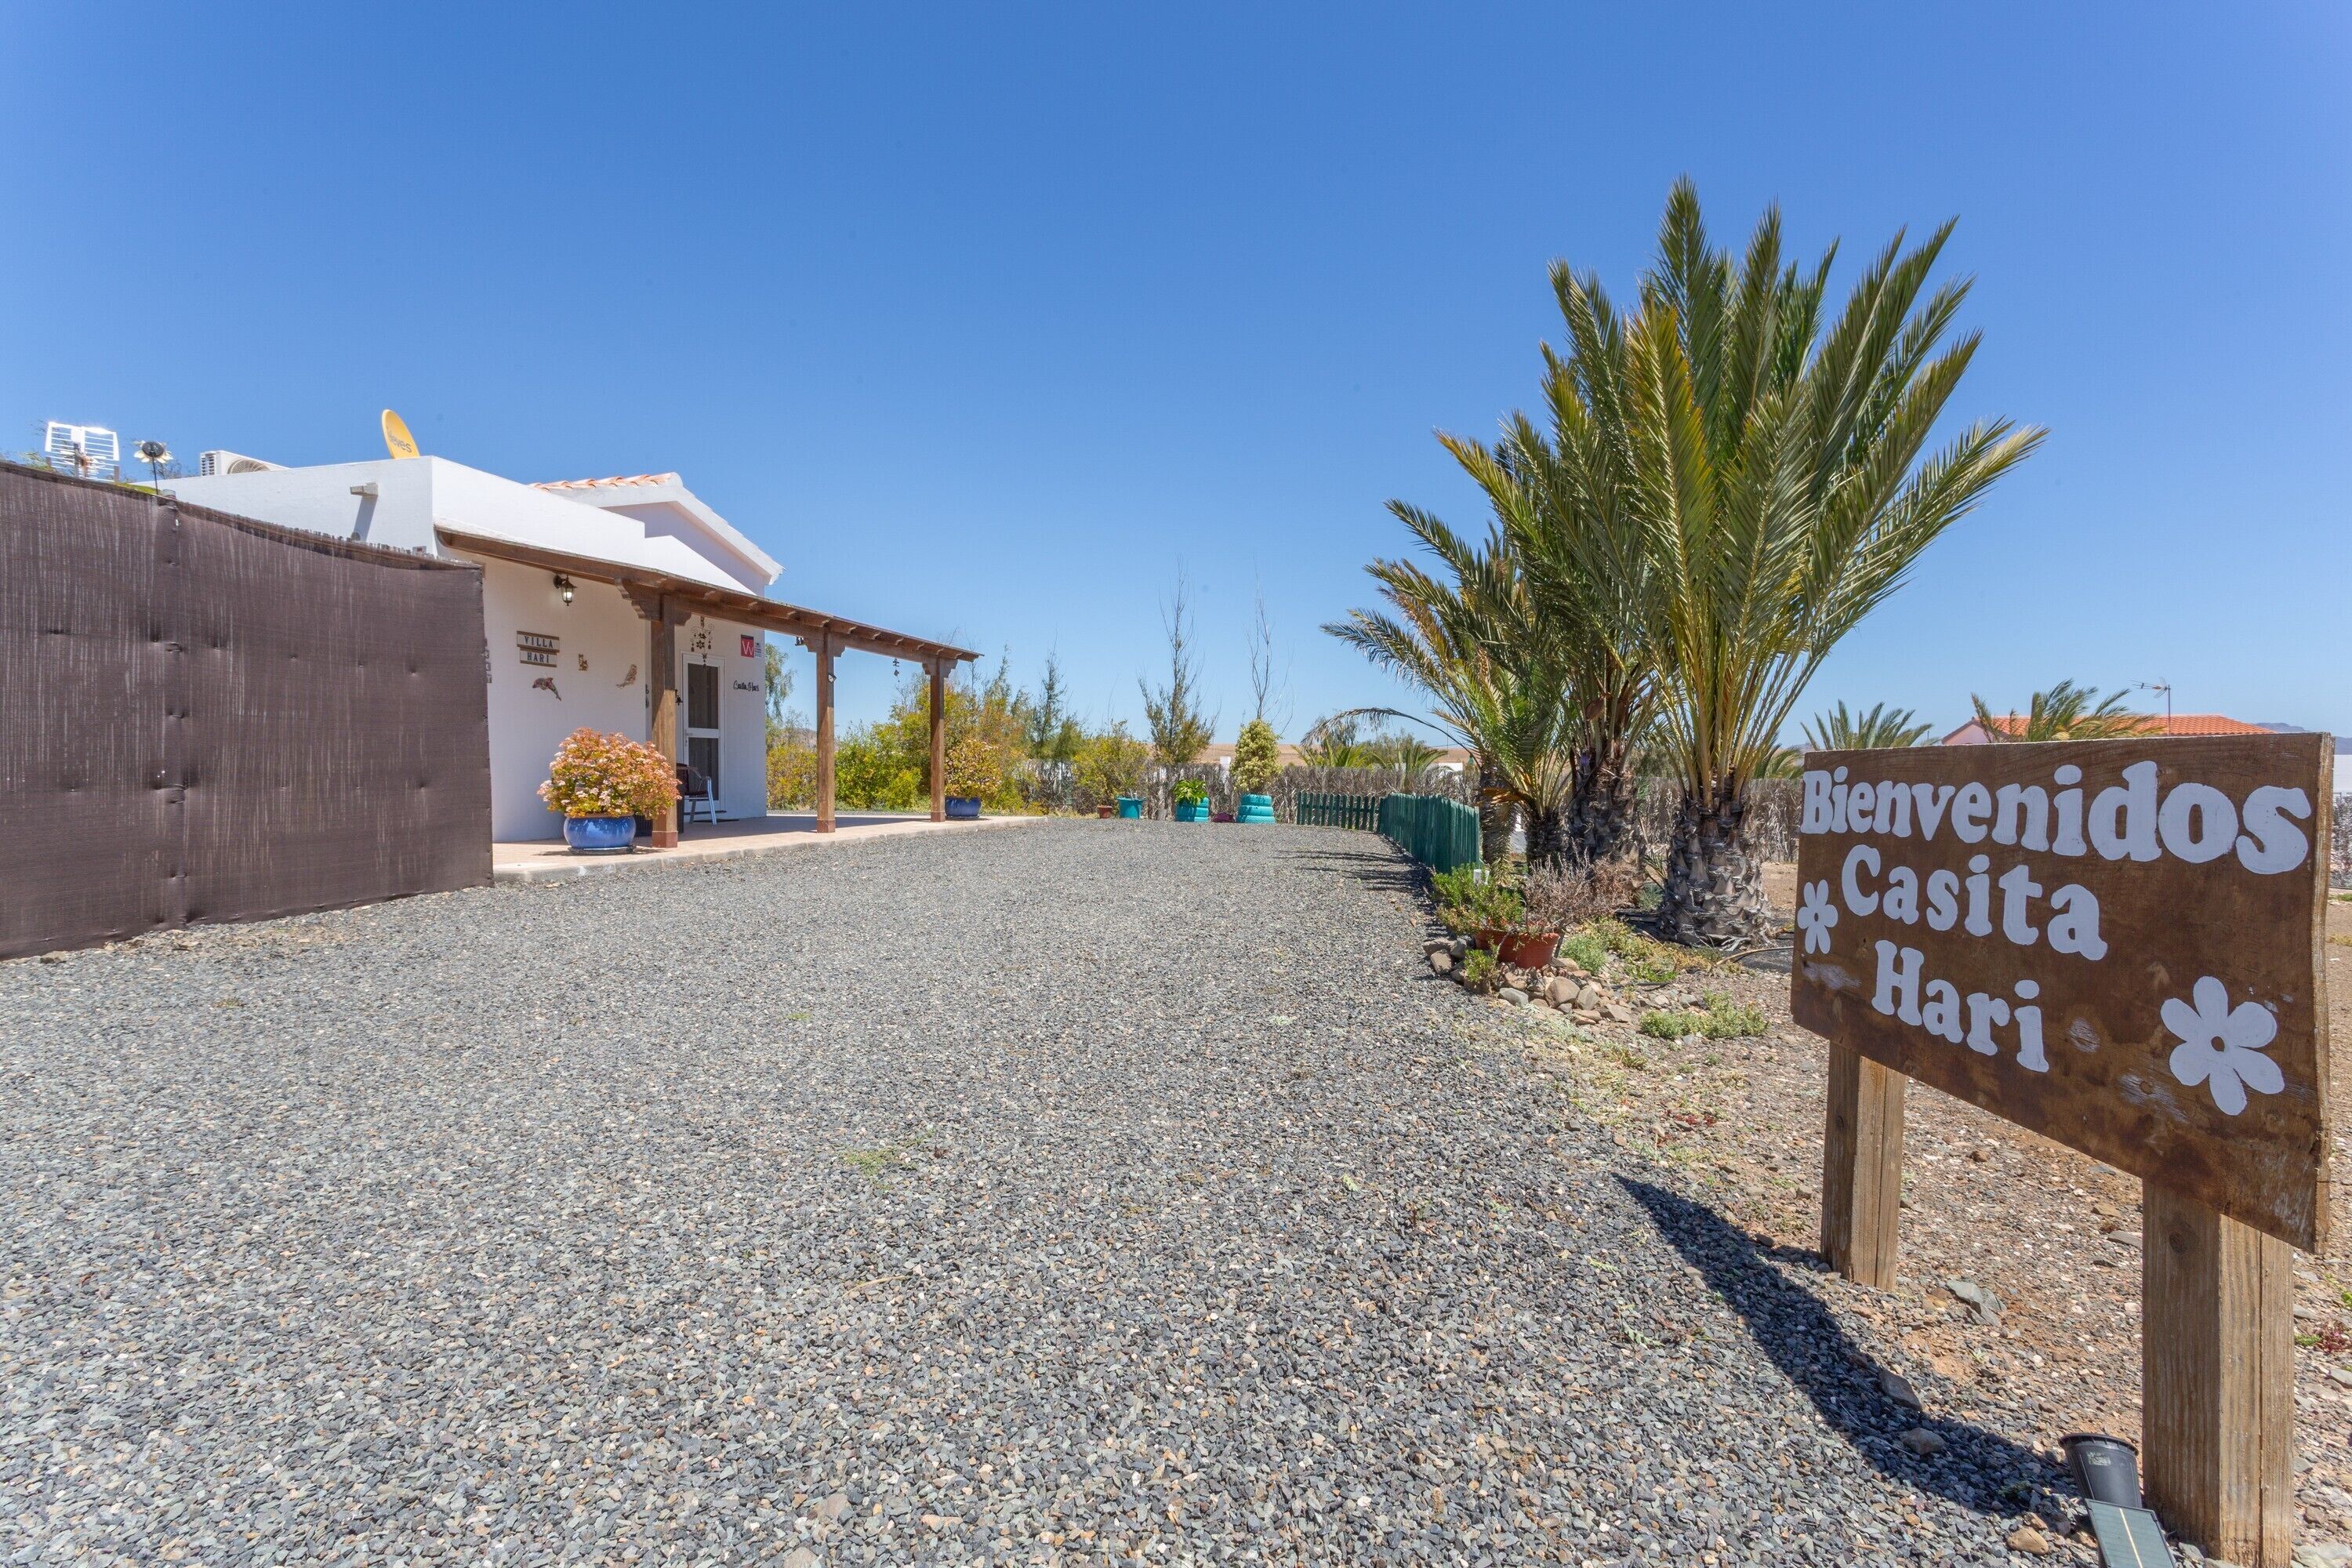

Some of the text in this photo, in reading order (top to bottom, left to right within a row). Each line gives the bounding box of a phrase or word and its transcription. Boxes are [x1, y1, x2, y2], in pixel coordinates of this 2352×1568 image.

[524, 636, 554, 648] VILLA
[527, 652, 550, 663] HARI
[1799, 760, 2312, 875] Bienvenidos
[1841, 844, 2108, 961] Casita
[1871, 940, 2050, 1073] Hari
